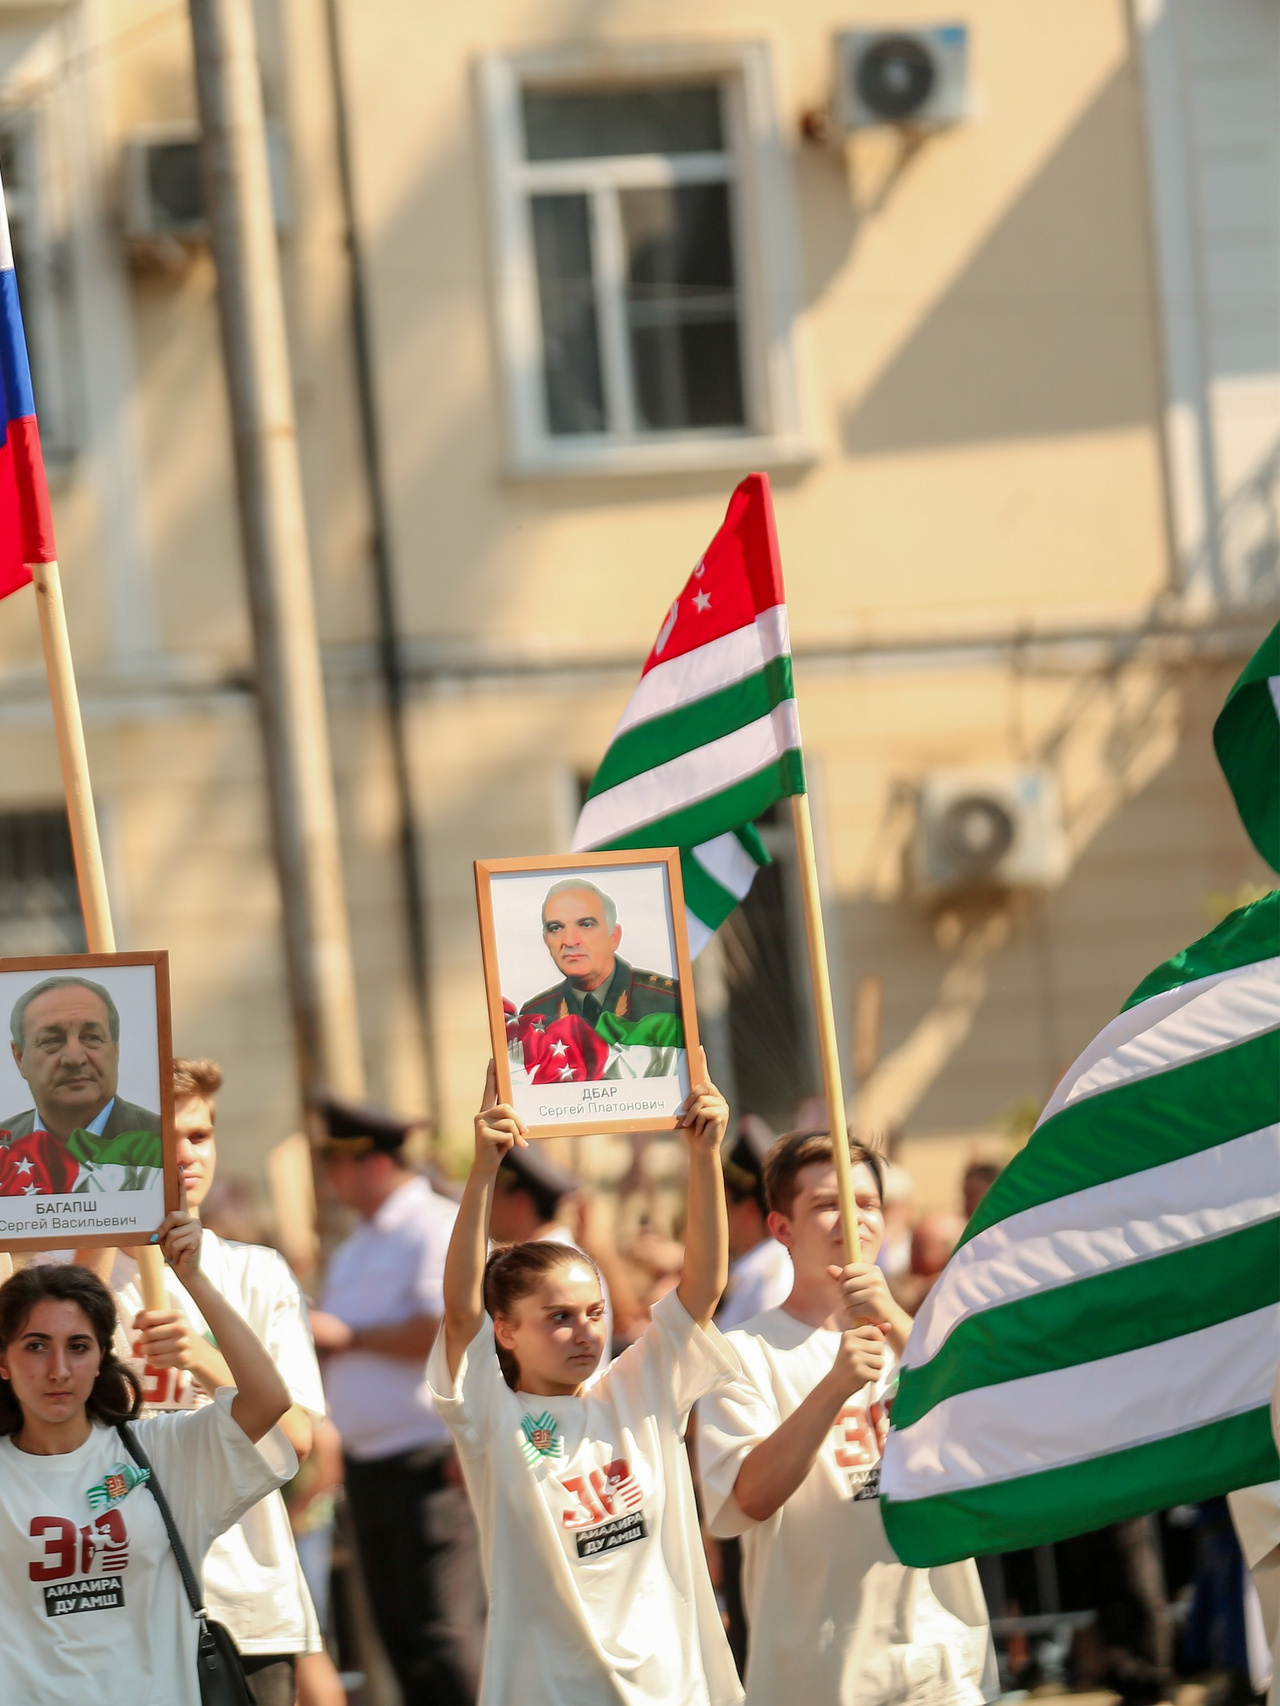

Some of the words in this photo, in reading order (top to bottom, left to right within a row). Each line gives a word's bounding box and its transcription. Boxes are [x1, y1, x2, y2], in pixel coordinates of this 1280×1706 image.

[582, 1086, 618, 1101] ДБАР
[539, 1102, 585, 1118] Сергей
[588, 1099, 665, 1114] Платонович
[36, 1200, 97, 1214] БАГАПШ
[52, 1215, 137, 1230] Васильевич
[577, 1511, 644, 1542] АИААИРА
[584, 1537, 606, 1555] ДУ
[607, 1526, 642, 1547] АМШ
[46, 1577, 121, 1598] АИААИРА
[55, 1599, 77, 1615] ДУ
[79, 1593, 119, 1609] АМШ
